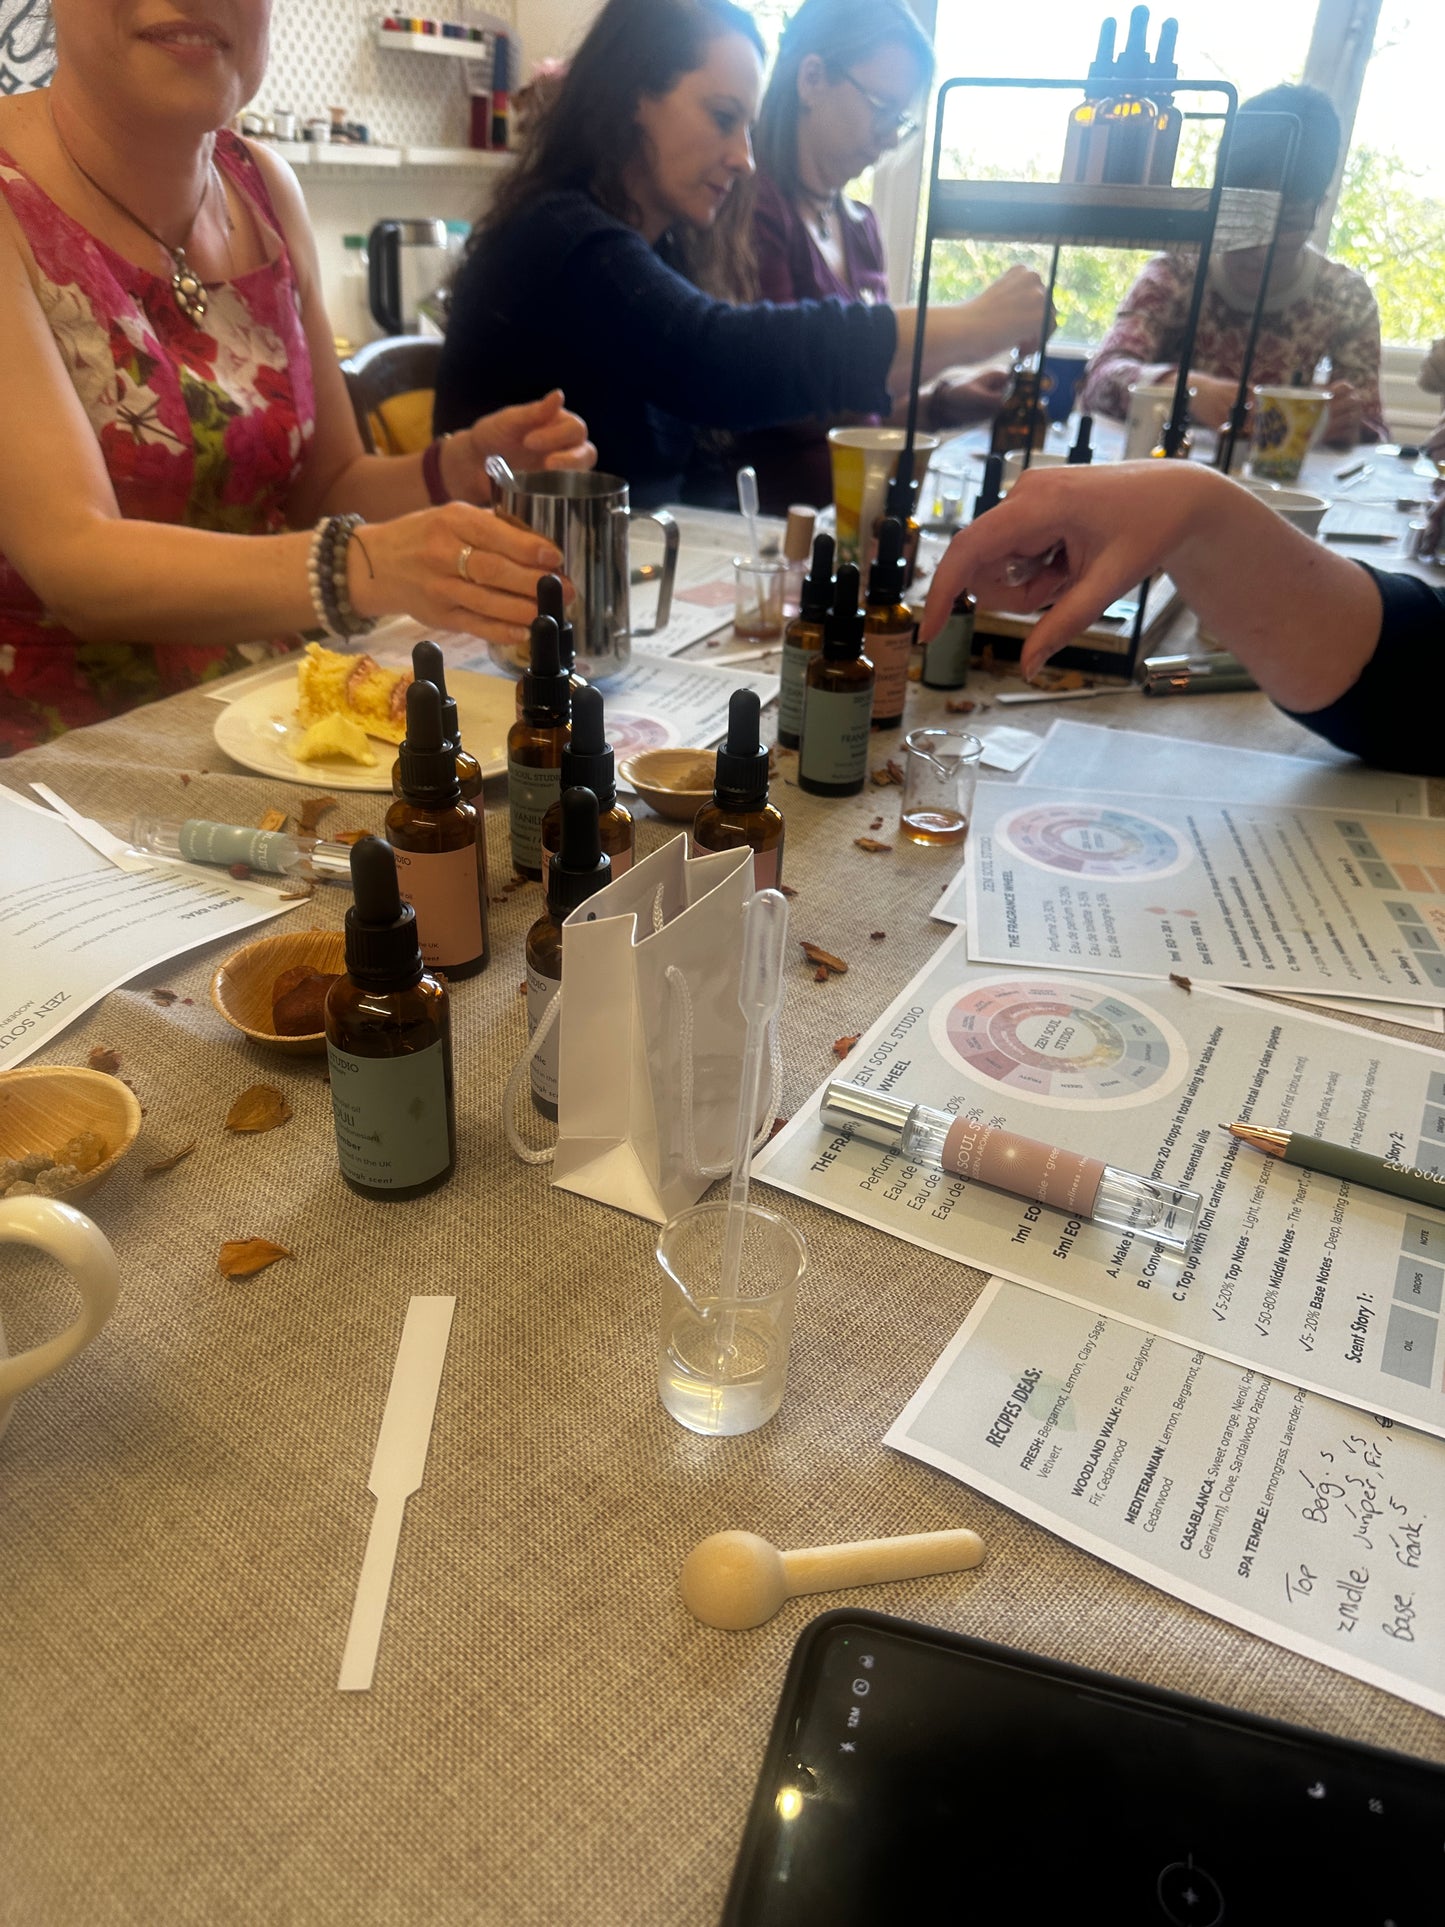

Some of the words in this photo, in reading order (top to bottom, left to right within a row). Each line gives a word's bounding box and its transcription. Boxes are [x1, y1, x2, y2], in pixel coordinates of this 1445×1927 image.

[1002, 870, 1014, 892] WHEEL
[1005, 892, 1019, 934] FRAGRANCE
[1008, 935, 1020, 949] THE
[34, 991, 72, 1020] ZEN
[0, 1018, 37, 1050] SOU
[1034, 1035, 1050, 1050] ZEN
[1044, 1018, 1063, 1037] SOUL
[1054, 1026, 1076, 1051] STUDIO
[1207, 1025, 1224, 1047] below
[851, 1066, 875, 1087] ZEN
[869, 1042, 899, 1066] SOUL
[891, 1006, 925, 1039] STUDIO
[1200, 1045, 1215, 1064] table
[1259, 1049, 1274, 1068] clean
[1193, 1063, 1207, 1076] the
[1252, 1067, 1268, 1088] using
[1186, 1076, 1204, 1097] using
[1244, 1086, 1259, 1106] total
[810, 1151, 837, 1172] THE
[877, 1060, 911, 1092] WHEEL
[1177, 1096, 1192, 1115] total
[1171, 1115, 1184, 1124] in
[1352, 1110, 1367, 1132] blend
[1163, 1123, 1182, 1147] drops
[1196, 1129, 1211, 1144] oils
[1349, 1132, 1361, 1145] the
[957, 1132, 977, 1170] SOUL
[1046, 1147, 1060, 1171] gree
[1157, 1146, 1172, 1159] 20
[1385, 1141, 1406, 1161] Story
[859, 1143, 901, 1191] Perfume
[1216, 1161, 1233, 1179] into
[1258, 1160, 1274, 1184] scents
[368, 1176, 393, 1184] scent
[883, 1179, 906, 1201] Eau
[900, 1165, 917, 1180] de
[1338, 1176, 1354, 1198] scen
[907, 1188, 930, 1211] Eau
[923, 1174, 940, 1189] de
[931, 1198, 955, 1220] Eau
[948, 1182, 965, 1198] de
[1208, 1178, 1226, 1208] carrier
[1250, 1184, 1266, 1205] fresh
[1197, 1207, 1216, 1231] 10ml
[1242, 1206, 1261, 1230] Light,
[1329, 1197, 1349, 1225] lasting
[1010, 1224, 1032, 1244] 1ml
[1024, 1205, 1042, 1223] EO
[1052, 1235, 1074, 1260] 5ml
[1063, 1220, 1082, 1238] EO
[1188, 1232, 1208, 1255] with
[1231, 1235, 1250, 1262] Notes
[1323, 1226, 1343, 1250] Deep,
[1419, 1229, 1430, 1246] NOTE
[1112, 1239, 1132, 1267] Make
[1142, 1239, 1165, 1277] Conver
[1186, 1255, 1200, 1270] up
[1105, 1267, 1121, 1279] A.
[1224, 1263, 1243, 1281] Top
[1257, 1289, 1278, 1325] 50-80%
[1268, 1256, 1288, 1289] Middle
[1278, 1228, 1295, 1256] Notes
[1287, 1206, 1301, 1222] The
[1315, 1256, 1333, 1285] Notes
[1136, 1279, 1151, 1289] B.
[1176, 1270, 1196, 1289] Top
[1412, 1272, 1424, 1294] DROPS
[1171, 1291, 1186, 1302] C.
[1215, 1281, 1235, 1310] 5-20%
[1309, 1285, 1326, 1309] Base
[1356, 1292, 1374, 1303] 1:
[1303, 1309, 1320, 1332] 20%
[1350, 1304, 1376, 1334] Story
[1344, 1333, 1366, 1363] Scent
[1403, 1340, 1414, 1351] OIL
[1019, 1437, 1045, 1471] FRESH:
[1037, 1395, 1070, 1438] Bergamot,
[1060, 1362, 1086, 1394] Lemon,
[1077, 1339, 1097, 1361] Clary
[1088, 1320, 1107, 1341] Sage,
[985, 1401, 1022, 1448] RECIPES
[1011, 1368, 1043, 1403] IDEAS:
[1071, 1439, 1107, 1497] WOODLAND
[1099, 1406, 1122, 1438] WALK:
[1114, 1385, 1134, 1407] Pine,
[1126, 1337, 1156, 1382] Eucalyptus,
[1280, 1404, 1304, 1446] Lavender,
[1125, 1446, 1165, 1524] MEDITERANIAN:
[1158, 1412, 1181, 1445] Lemon,
[1172, 1366, 1200, 1410] Bergamot,
[1036, 1445, 1063, 1479] Vetivert
[1096, 1438, 1128, 1491] Cedarwood
[1180, 1479, 1215, 1551] CASABLANCA:
[1207, 1446, 1228, 1477] Sweet
[1220, 1413, 1241, 1447] orange,
[1231, 1384, 1251, 1412] Neroli,
[1198, 1504, 1229, 1560] Geranium),
[1218, 1475, 1239, 1503] Clove,
[1229, 1415, 1260, 1473] Sandalwood,
[1261, 1448, 1290, 1507] Lemongrass,
[1088, 1492, 1105, 1507] Fir,
[1143, 1477, 1174, 1533] Cedarwood
[1245, 1507, 1269, 1553] TEMPLE:
[1237, 1555, 1254, 1578] SPA
[1286, 1564, 1318, 1603] Top
